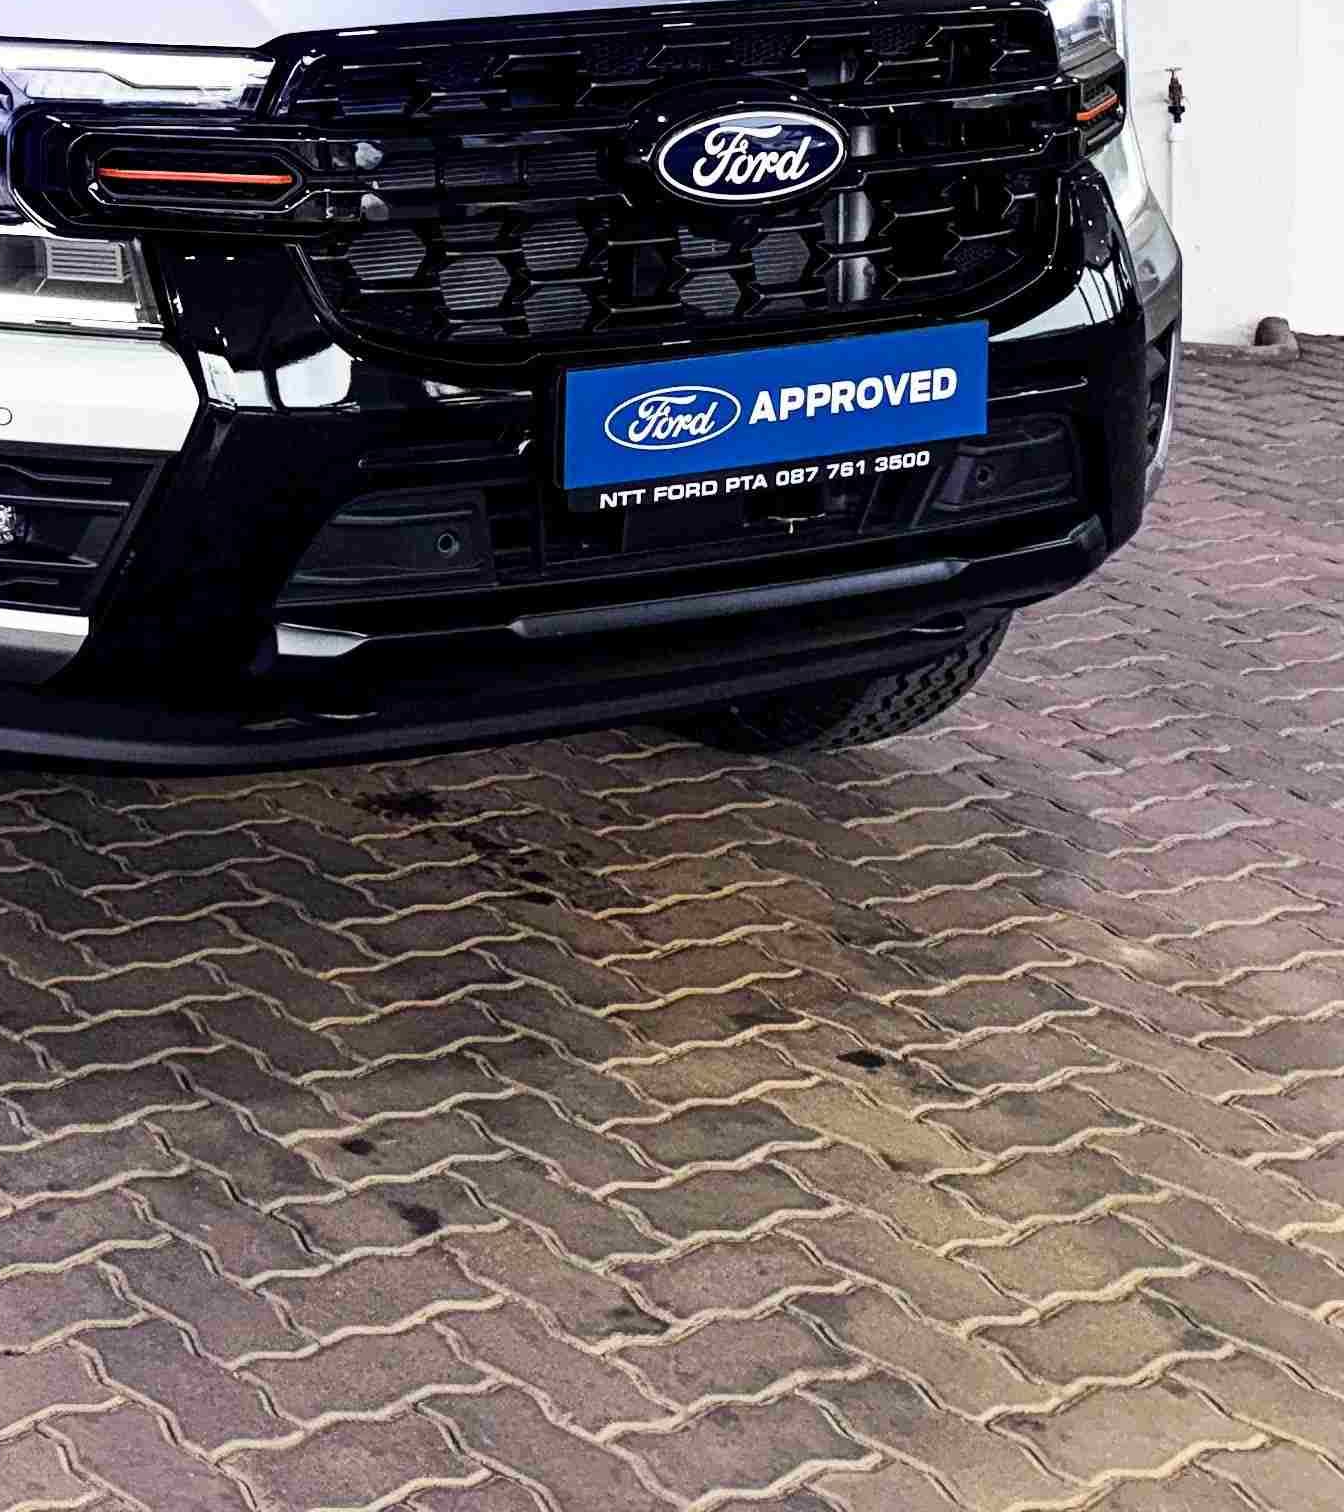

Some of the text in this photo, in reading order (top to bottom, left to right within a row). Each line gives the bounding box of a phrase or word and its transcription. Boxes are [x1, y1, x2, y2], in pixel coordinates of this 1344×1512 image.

[691, 125, 810, 187] Ford
[628, 368, 959, 444] Ford APPROVED
[599, 451, 932, 510] NTT FORD PTA 087 761 3500
